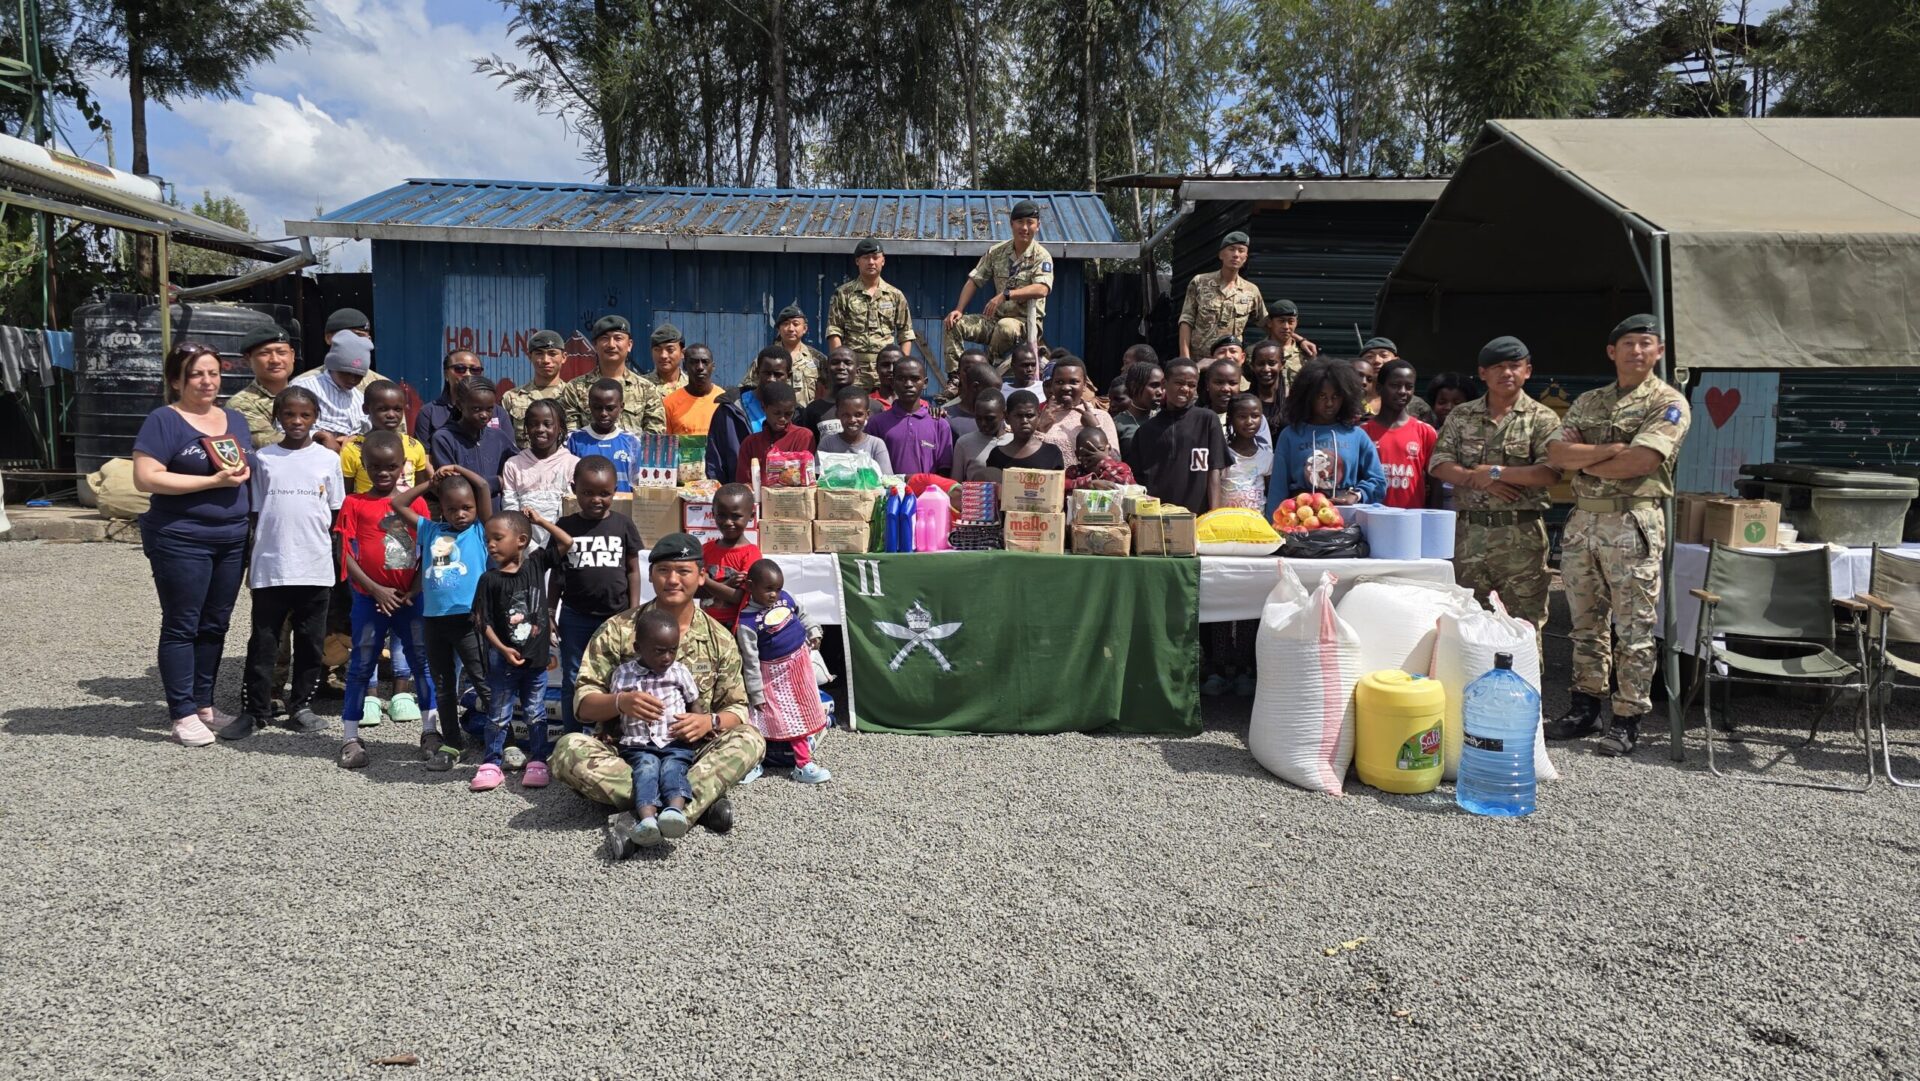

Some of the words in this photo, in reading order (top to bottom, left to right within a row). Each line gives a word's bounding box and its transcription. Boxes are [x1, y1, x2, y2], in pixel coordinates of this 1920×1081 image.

[1190, 448, 1209, 471] N
[1380, 463, 1414, 478] EMA
[1009, 515, 1049, 531] mallo
